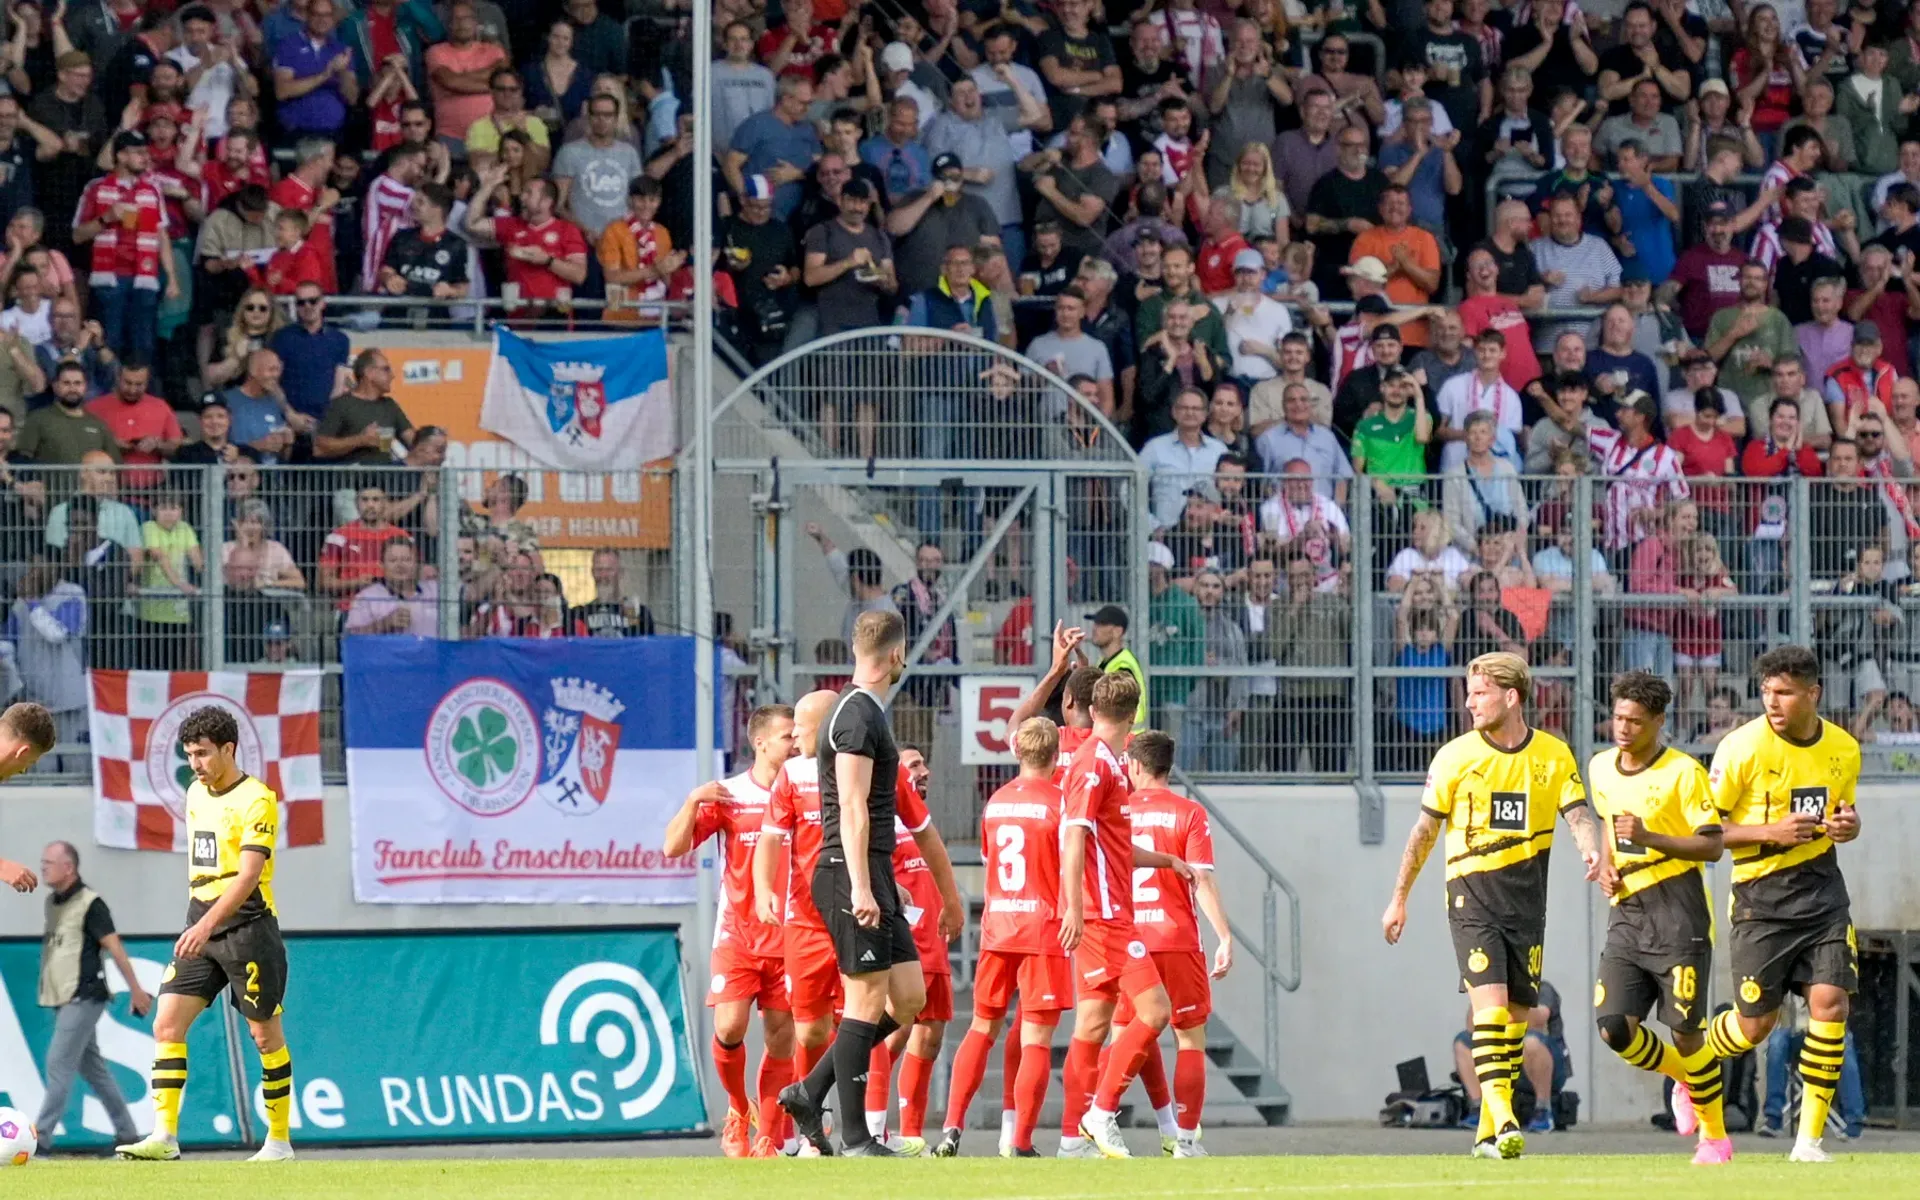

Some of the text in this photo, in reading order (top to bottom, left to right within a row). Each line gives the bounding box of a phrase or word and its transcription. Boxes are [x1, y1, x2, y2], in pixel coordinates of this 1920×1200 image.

[568, 517, 639, 537] HEIMAT
[975, 686, 1021, 752] 5
[1493, 800, 1524, 821] 1&1
[195, 837, 215, 859] 1&1
[373, 839, 484, 872] Fanclub
[996, 825, 1026, 892] 3
[246, 961, 260, 992] 2
[1528, 944, 1542, 977] 30
[1672, 964, 1697, 1000] 16
[380, 1069, 605, 1127] RUNDAS
